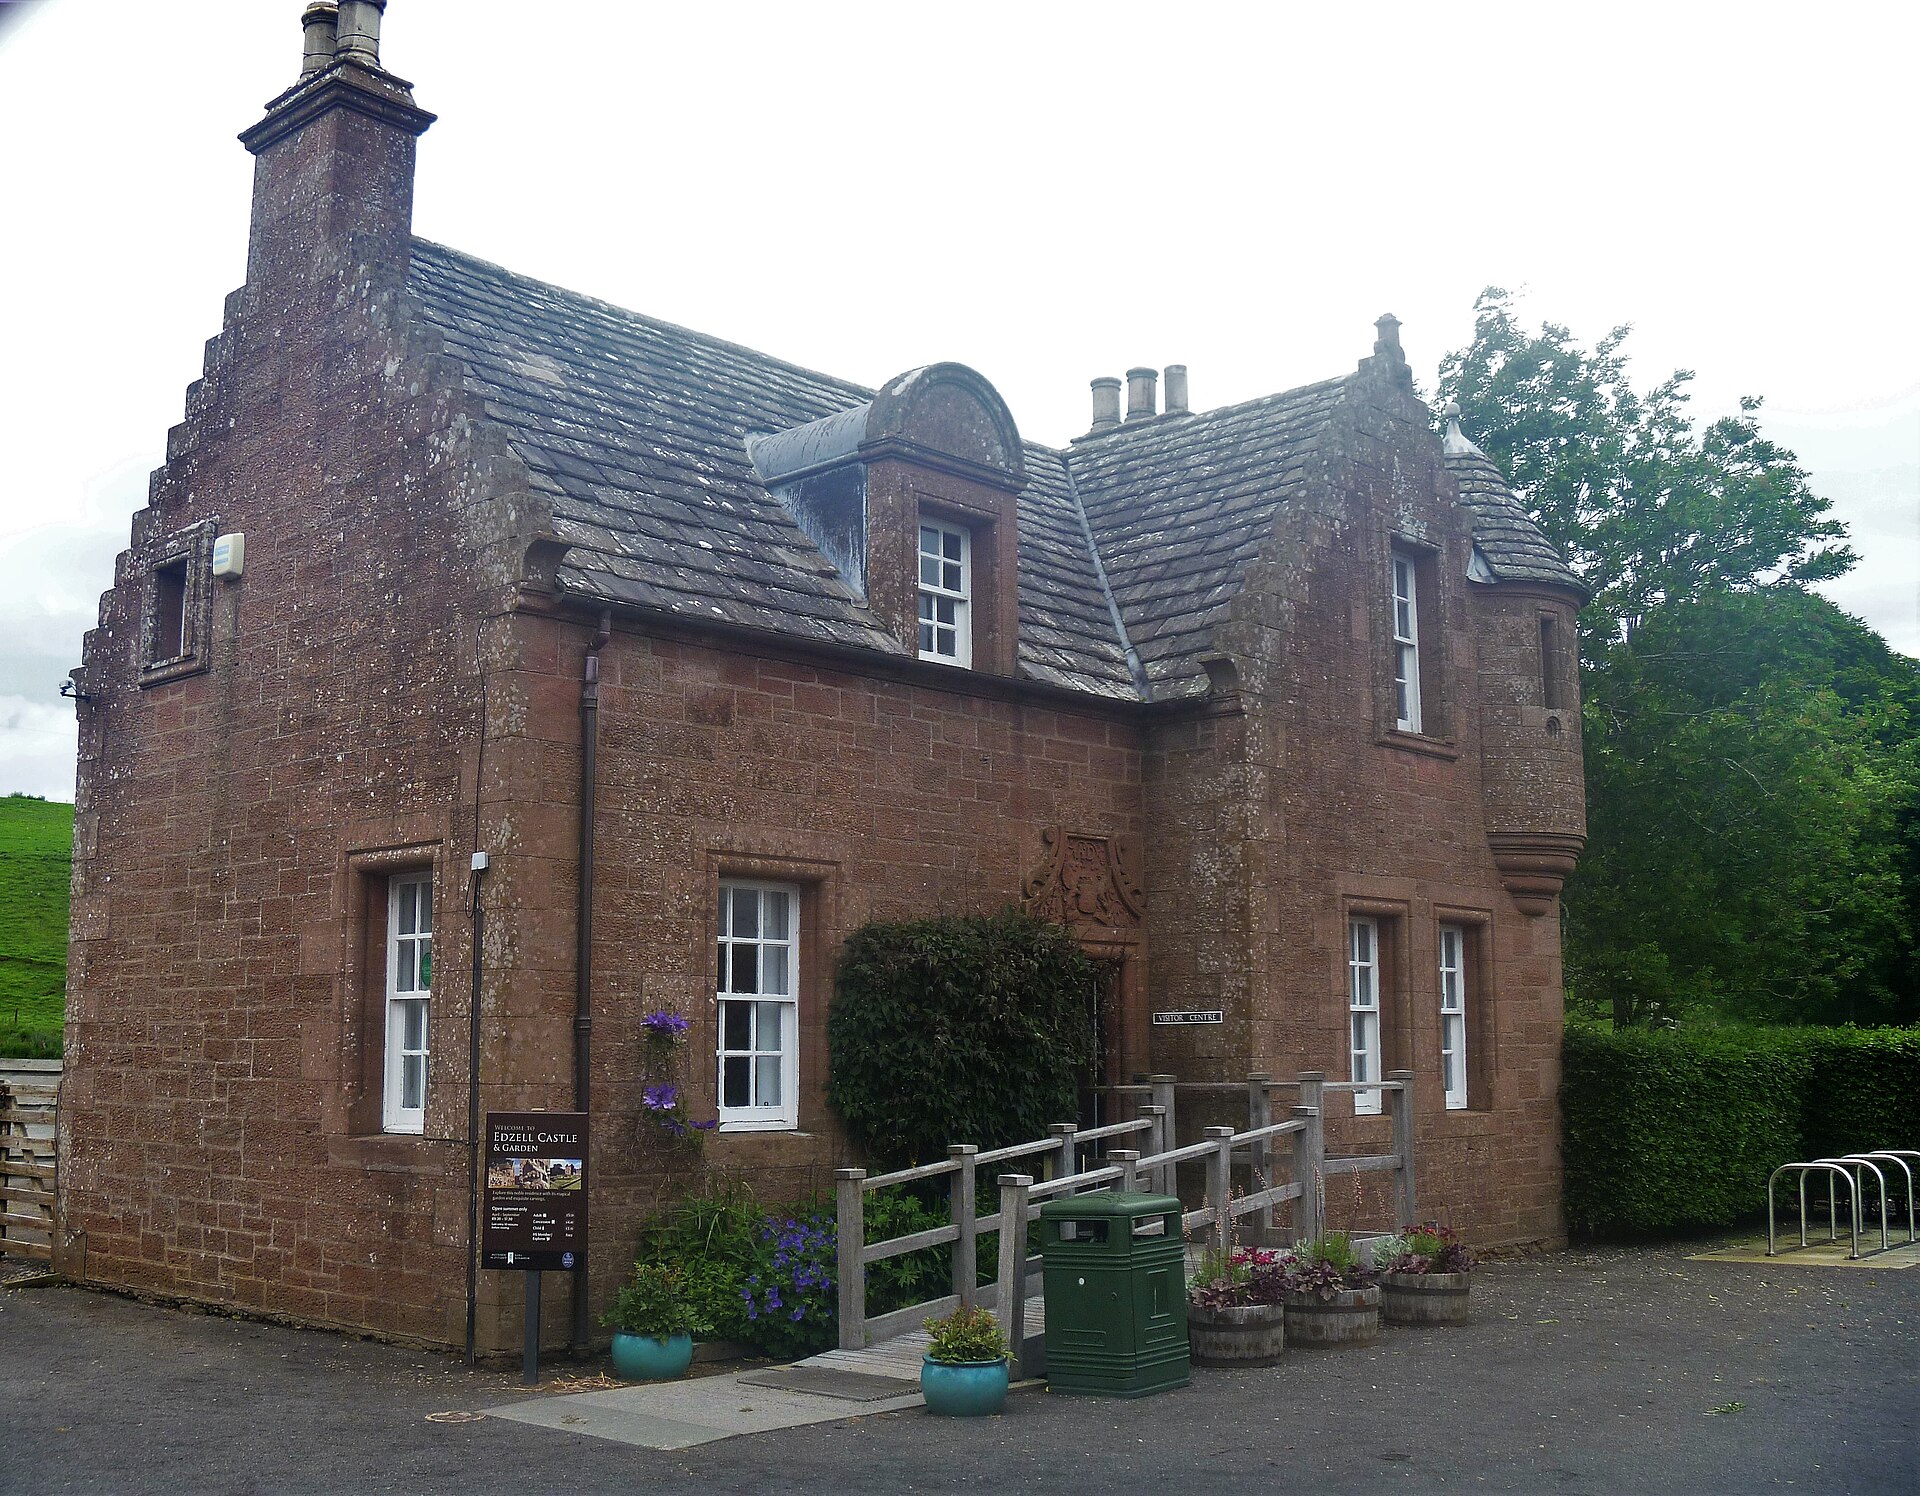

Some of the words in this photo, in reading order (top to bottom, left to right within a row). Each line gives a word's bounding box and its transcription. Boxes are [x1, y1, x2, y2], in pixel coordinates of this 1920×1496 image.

[494, 1132, 534, 1142] EDZELL
[537, 1132, 578, 1143] CASTLE
[493, 1144, 501, 1152] &
[502, 1144, 539, 1153] GARDEN
